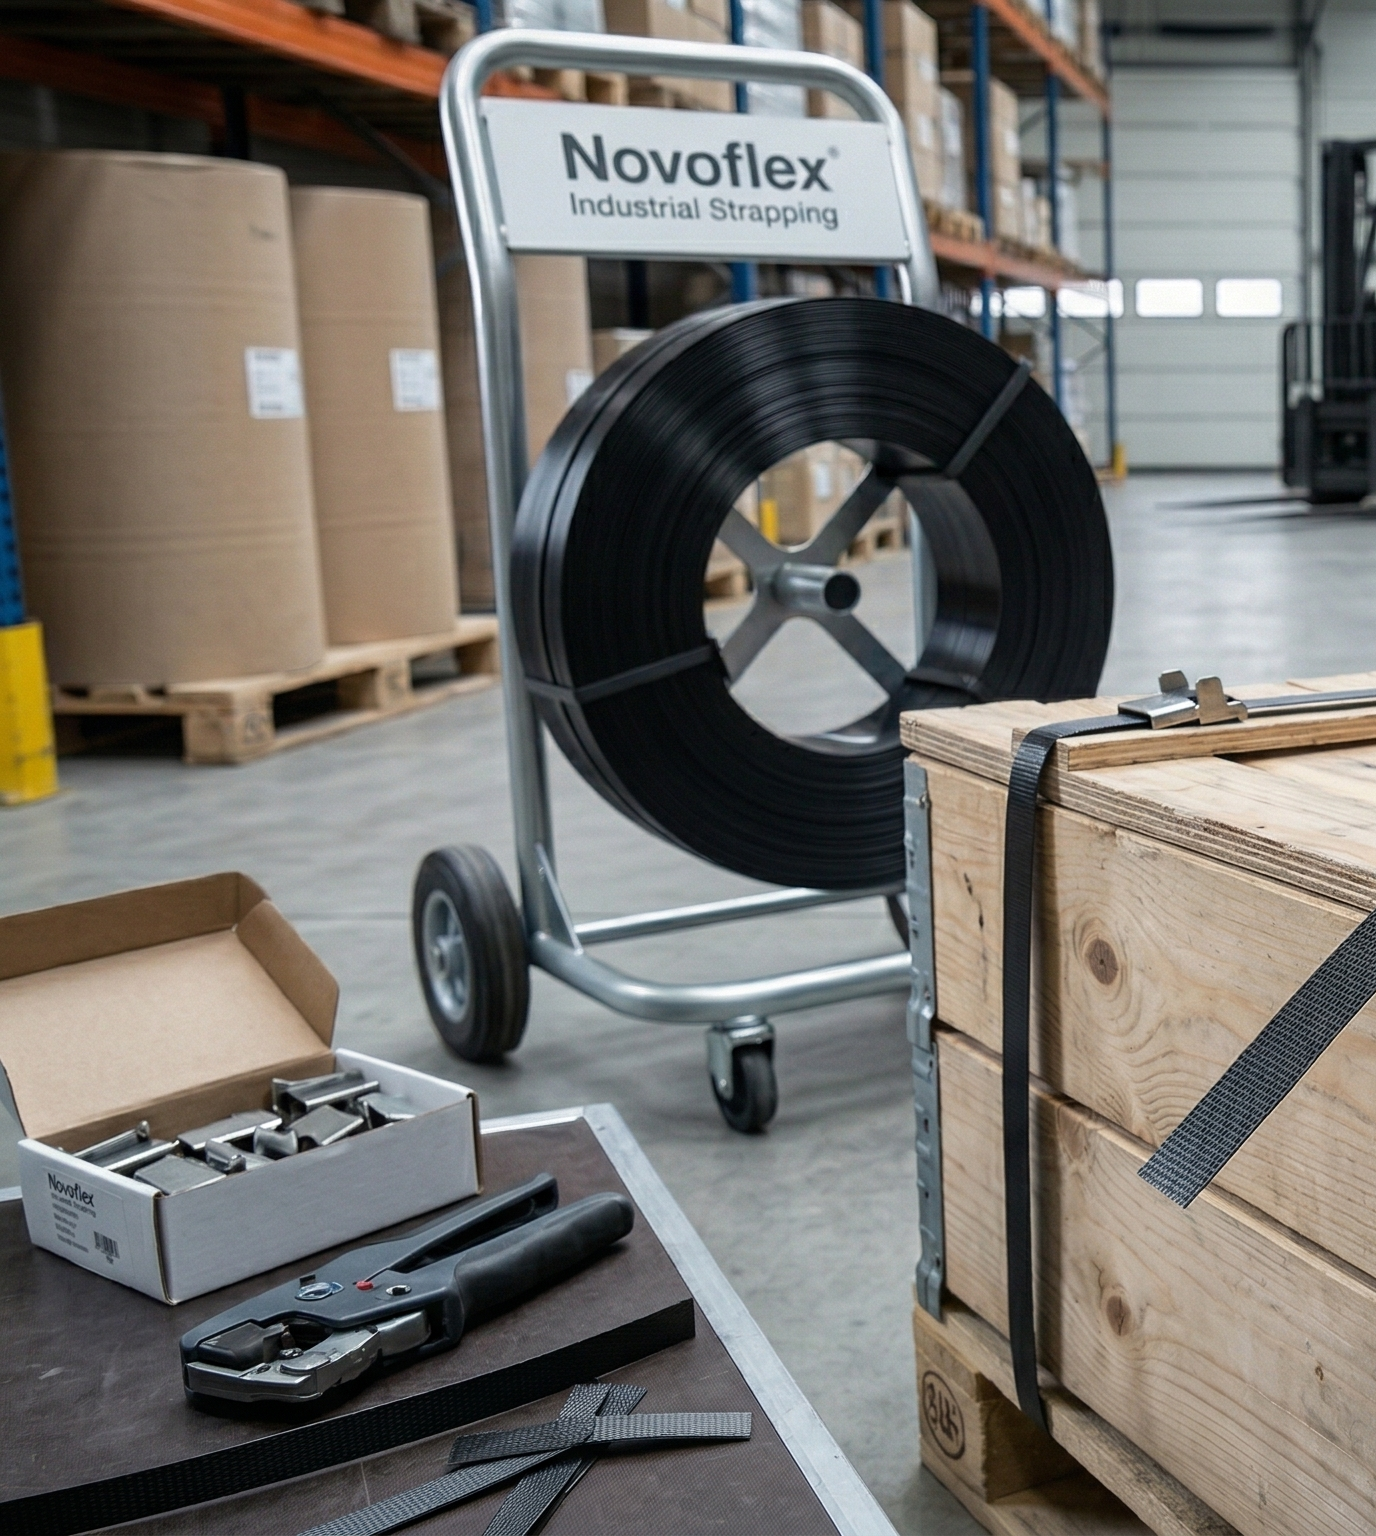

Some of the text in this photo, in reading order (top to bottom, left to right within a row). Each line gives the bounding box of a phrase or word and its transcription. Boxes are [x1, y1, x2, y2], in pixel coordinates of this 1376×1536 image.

[560, 131, 833, 192] Novoflex
[570, 192, 839, 230] Industrial Strapping
[47, 1172, 95, 1208] Novoflex
